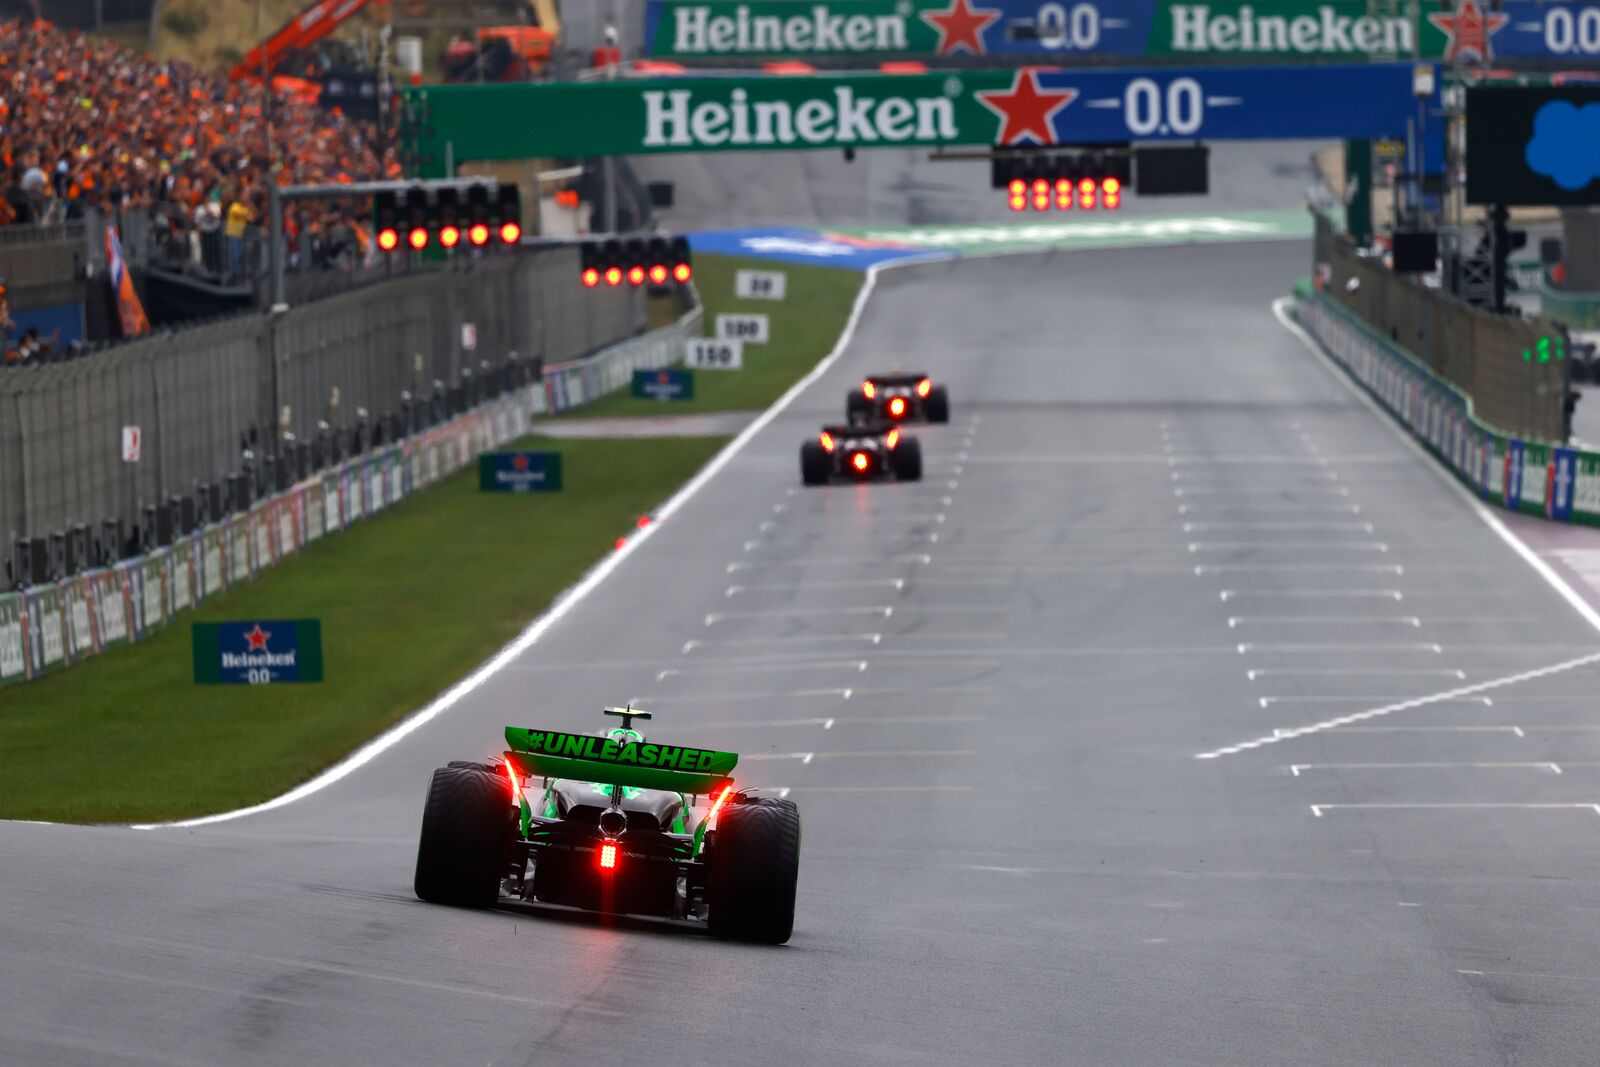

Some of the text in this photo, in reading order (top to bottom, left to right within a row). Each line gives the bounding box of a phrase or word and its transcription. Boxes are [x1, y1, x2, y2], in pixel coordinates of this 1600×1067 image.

[674, 7, 908, 51] Heineken
[1171, 5, 1414, 51] Heineken
[643, 87, 958, 145] Heineken
[1125, 78, 1203, 135] 0.0
[221, 651, 295, 668] Heineken
[529, 732, 715, 771] #UNLEASHED
